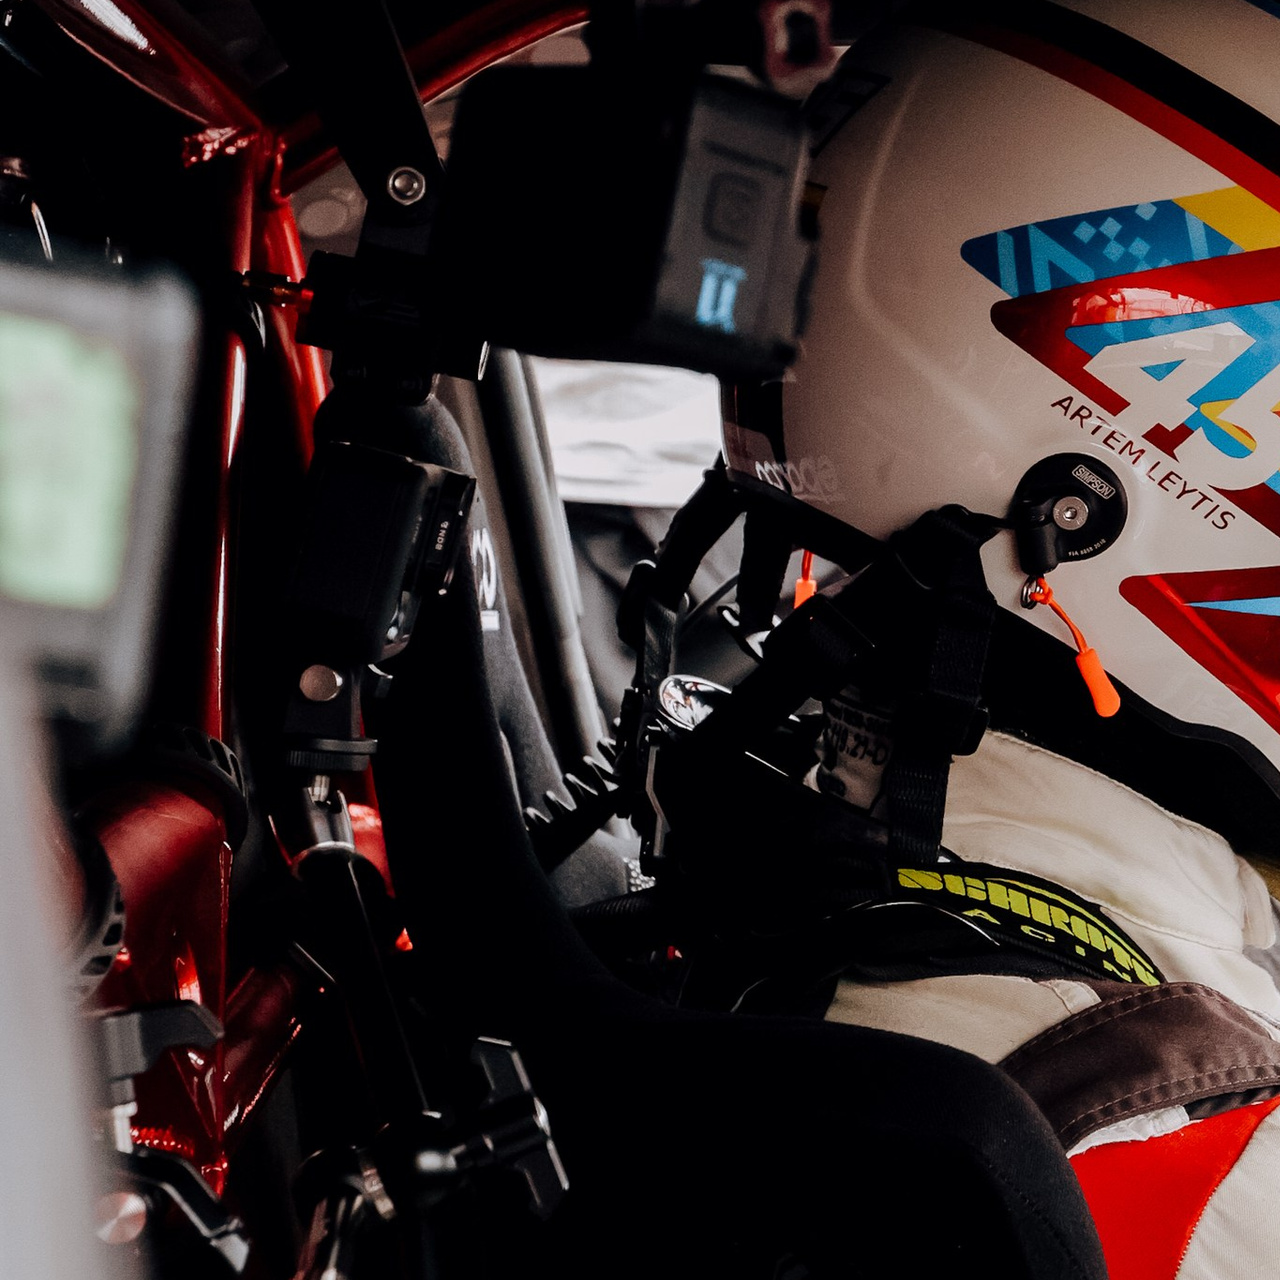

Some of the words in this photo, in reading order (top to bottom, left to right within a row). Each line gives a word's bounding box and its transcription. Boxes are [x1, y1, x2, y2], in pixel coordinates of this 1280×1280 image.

[1050, 395, 1145, 465] ARTEM
[1146, 460, 1236, 530] LEYTIS
[1075, 467, 1113, 497] SIMPSON
